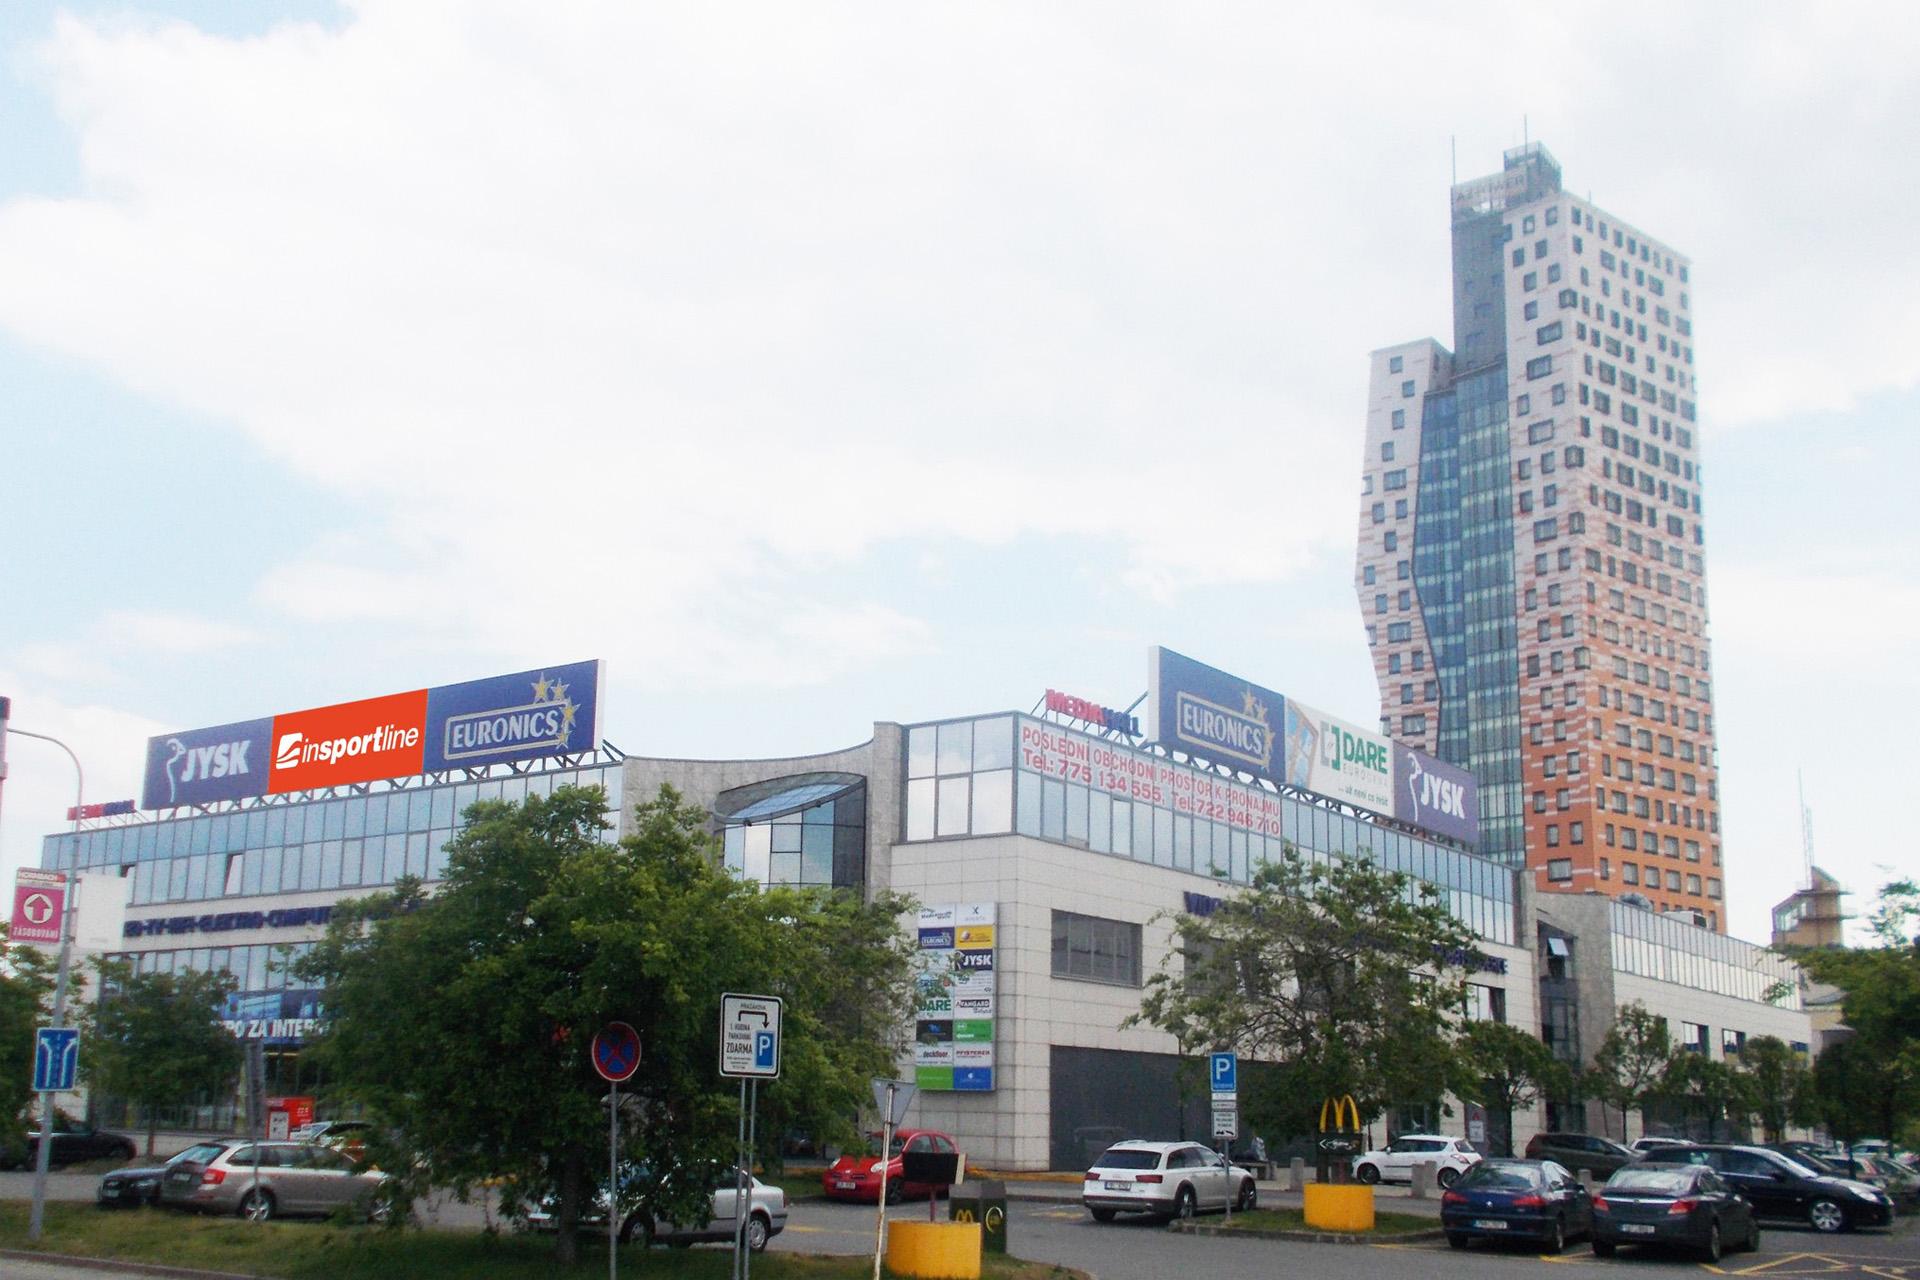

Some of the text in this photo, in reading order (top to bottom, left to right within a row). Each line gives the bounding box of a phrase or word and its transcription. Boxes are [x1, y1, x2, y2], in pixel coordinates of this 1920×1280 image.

[301, 724, 418, 764] insportline
[452, 711, 558, 749] EURONICS
[1184, 702, 1263, 752] EURONICS
[181, 740, 251, 782] JYSK
[1343, 731, 1388, 775] DARE
[1058, 759, 1092, 784] 775
[1099, 770, 1127, 793] 134
[1227, 807, 1253, 828] 946
[1257, 816, 1280, 835] 710
[1160, 769, 1212, 798] PROSTOR
[1215, 785, 1222, 799] K
[1421, 773, 1466, 819] JYSK
[963, 954, 992, 966] JYSK
[247, 1020, 268, 1038] ZA
[726, 1042, 753, 1054] ZDARMA
[759, 1035, 770, 1057] P
[1215, 1057, 1231, 1080] P
